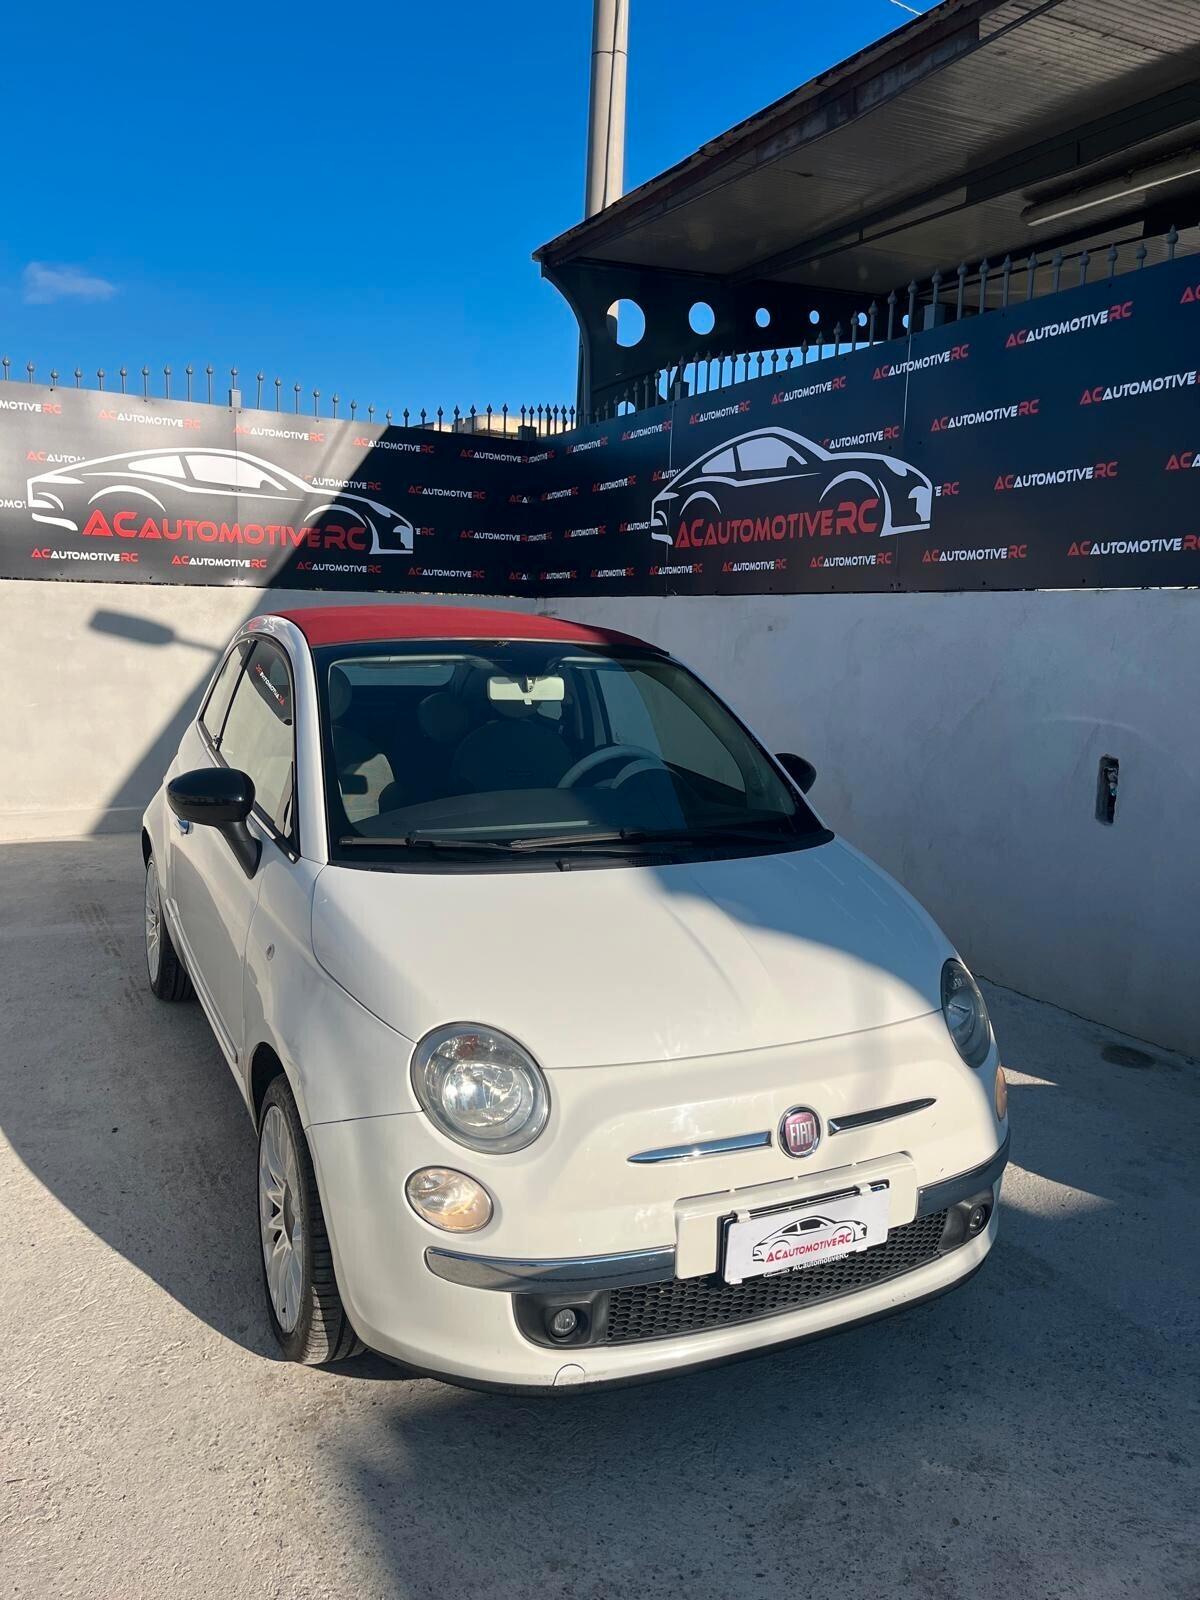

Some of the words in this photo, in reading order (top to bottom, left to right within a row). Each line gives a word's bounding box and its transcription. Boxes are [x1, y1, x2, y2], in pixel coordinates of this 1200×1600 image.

[1005, 300, 1134, 349] ACAUTOMOTIVERC
[872, 343, 970, 381] ACAUTOMOTIVERC
[771, 375, 847, 406] ACAUTOMOTIVERC
[1079, 370, 1200, 406] ACAUTOMOTIVE
[98, 409, 201, 429] ACAUTOMOTIVERC
[689, 400, 750, 425] ACAUTOMOTIVERC
[930, 399, 1040, 432] ACAUTOMOTIVERC
[233, 424, 325, 442] ACAUTOMOTIVERC
[621, 419, 673, 441] ACAUTOMOTIVERC
[353, 436, 435, 454] ACAUTOMOTIVERC
[565, 435, 609, 454] ACAUTOMOTIVERC
[592, 474, 637, 493] ACAUTOMOTIVERC
[994, 461, 1119, 491] ACAUTOMOTIVERC
[408, 484, 487, 500] ACAUTOMOTIVERC
[82, 509, 367, 550] ACAUTOMOTIVERC
[674, 497, 880, 548] ACAUTOMOTIVERC
[31, 548, 139, 563] ACAUTOMOTIVERC
[921, 544, 1028, 564] ACAUTOMOTIVERC
[1067, 534, 1200, 557] ACAUTOMOTIVER
[171, 554, 268, 569] ACAUTOMOTIVERC
[296, 560, 383, 574] ACAUTOMOTIVERC
[648, 562, 703, 576] ACAUTOMOTIVERC
[722, 558, 788, 573] ACAUTOMOTIVERC
[809, 552, 893, 568] ACAUTOMOTIVERC
[408, 566, 486, 579] ACAUTOMOTIVERC
[590, 567, 635, 578] ACAUTOMOTIVERC
[789, 1119, 814, 1147] FIAT
[766, 1232, 852, 1263] ACAUTOMOTIVERC
